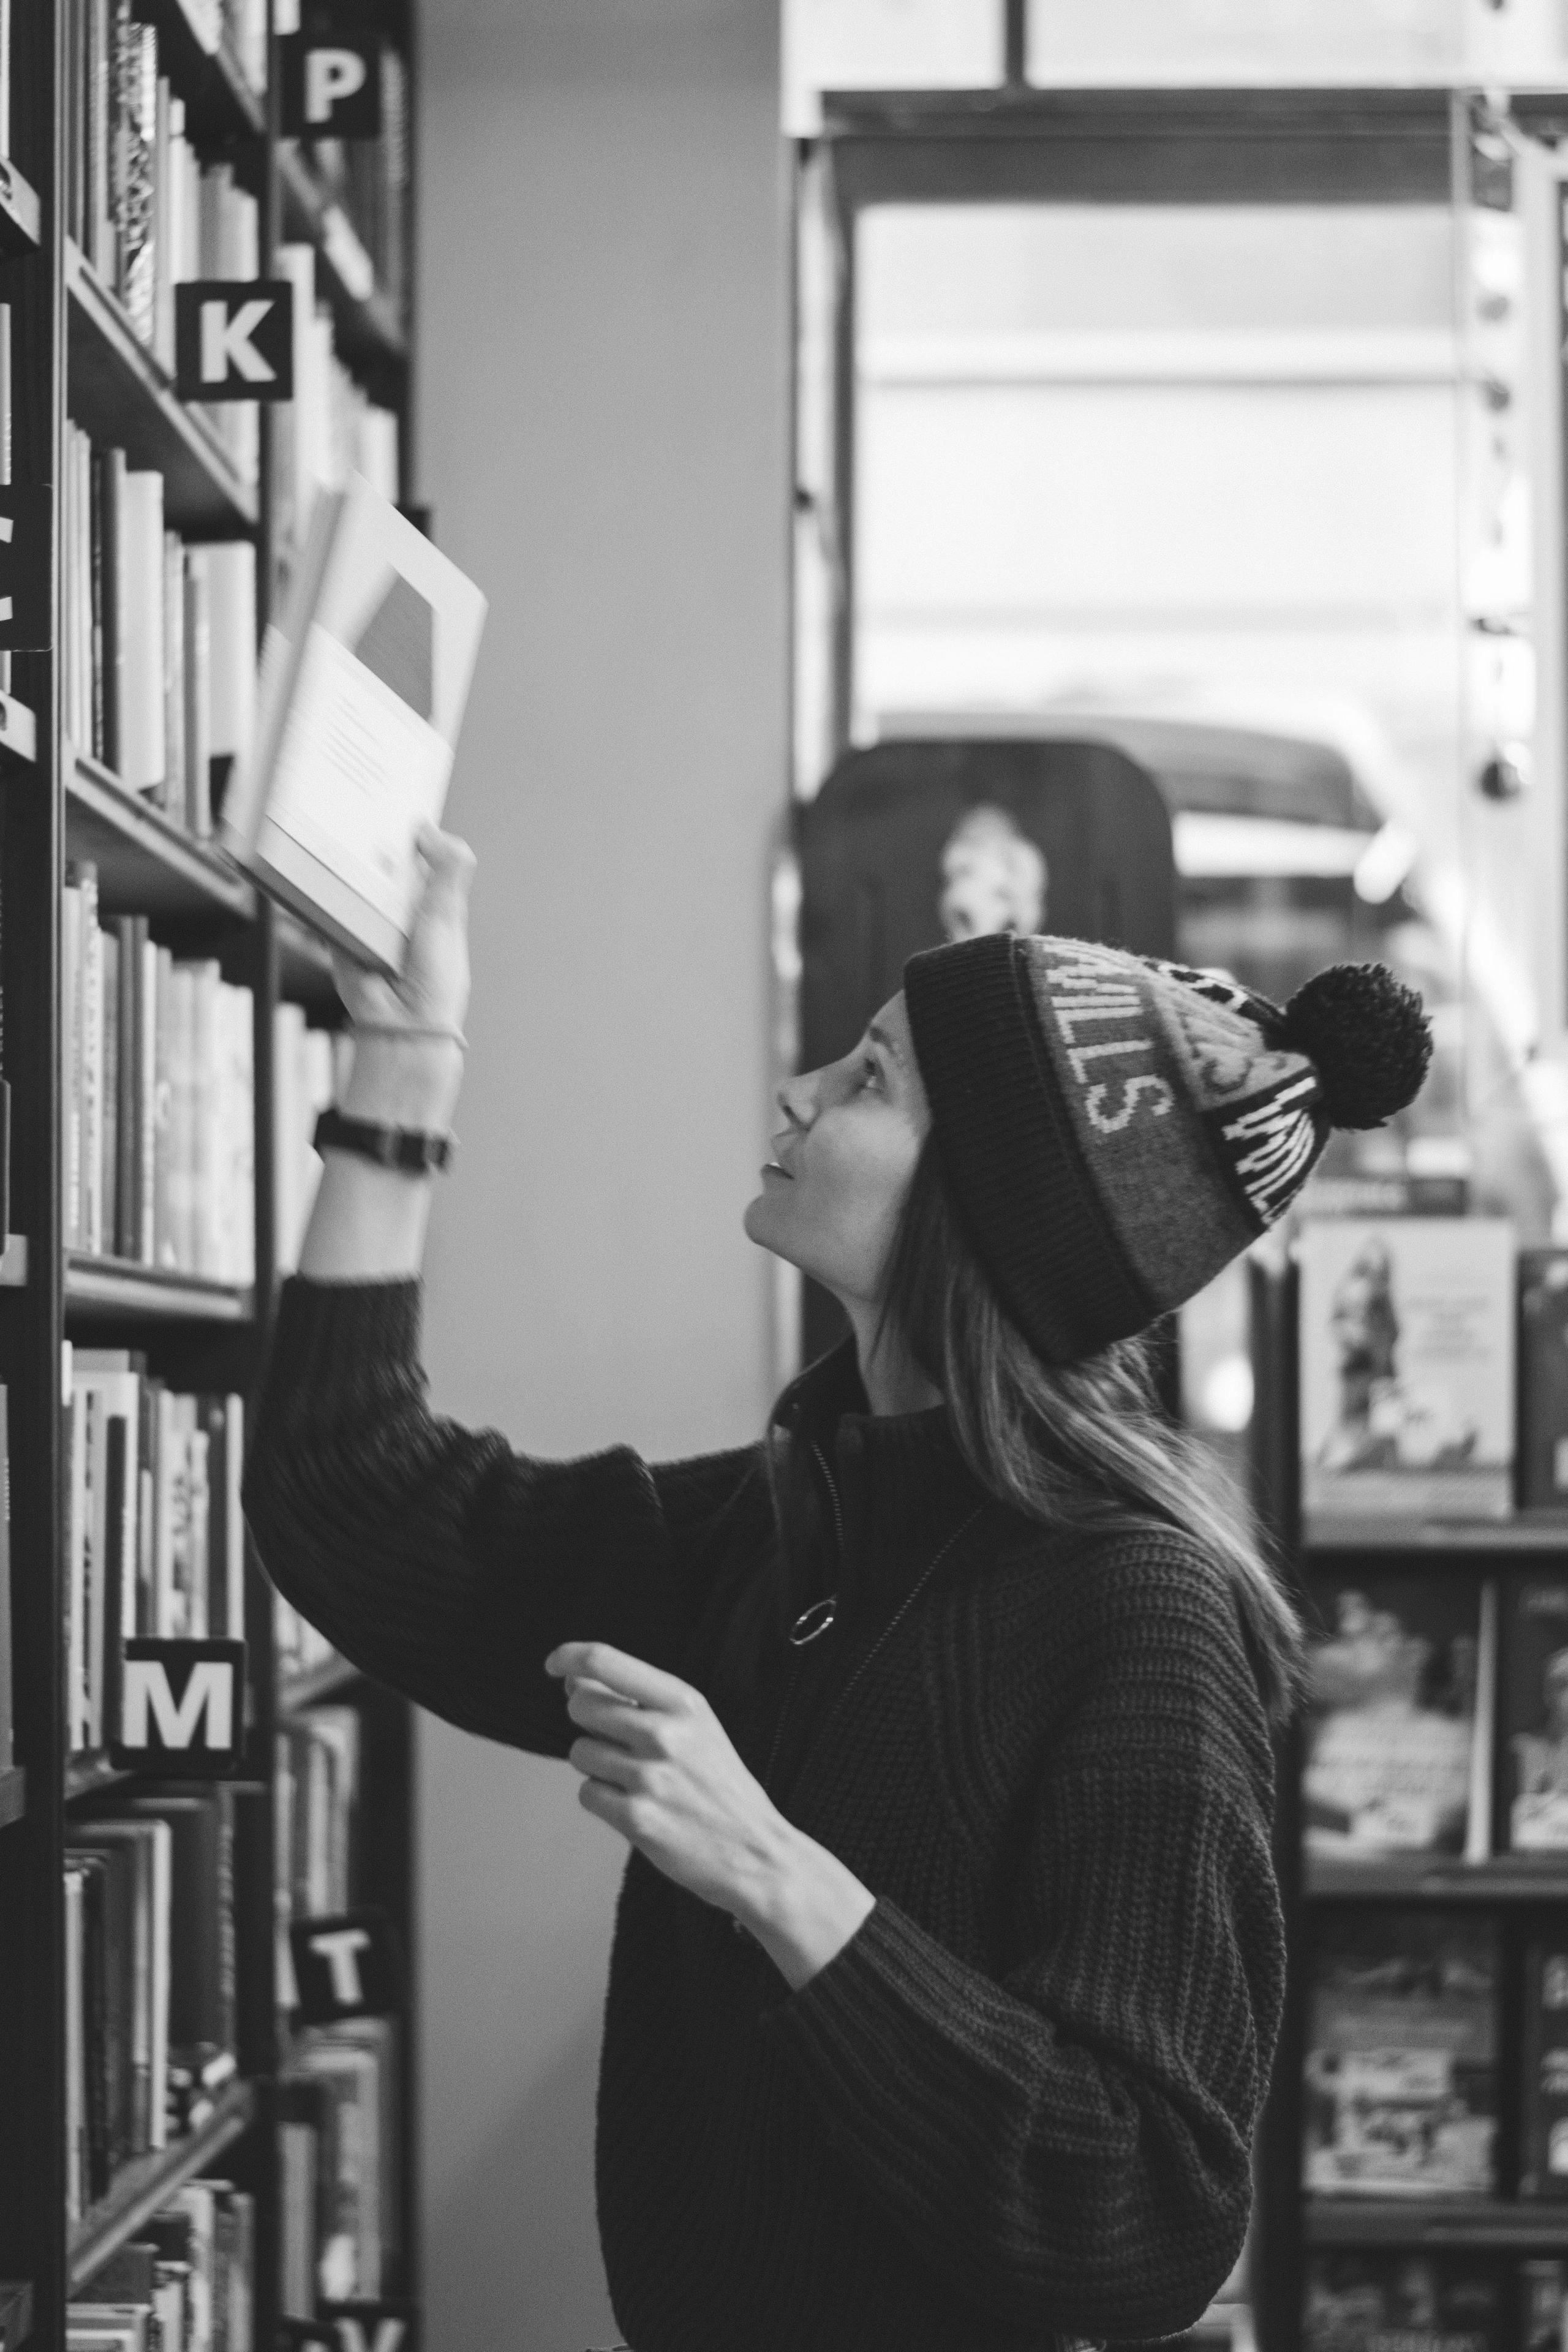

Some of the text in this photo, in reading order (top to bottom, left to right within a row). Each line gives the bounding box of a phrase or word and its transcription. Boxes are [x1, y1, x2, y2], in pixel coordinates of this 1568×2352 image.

[306, 48, 366, 122] P
[200, 300, 276, 383] K
[122, 1660, 233, 1749] M
[311, 1929, 369, 2005] T
